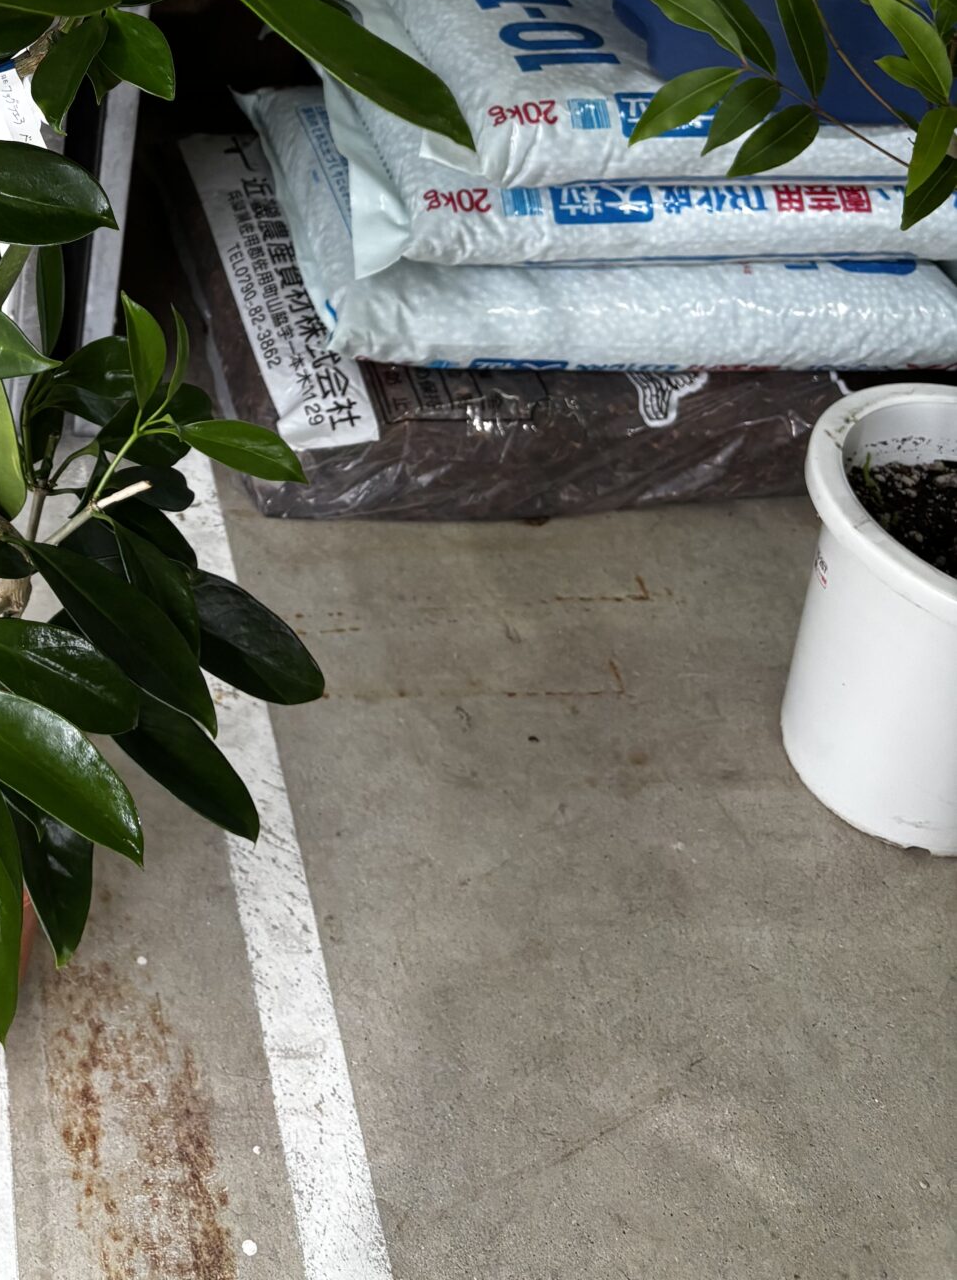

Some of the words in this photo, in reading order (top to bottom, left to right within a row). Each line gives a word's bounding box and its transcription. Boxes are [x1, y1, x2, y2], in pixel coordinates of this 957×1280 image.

[487, 99, 558, 126] 20kg
[423, 188, 492, 213] 20kg
[558, 185, 652, 216] 大粒
